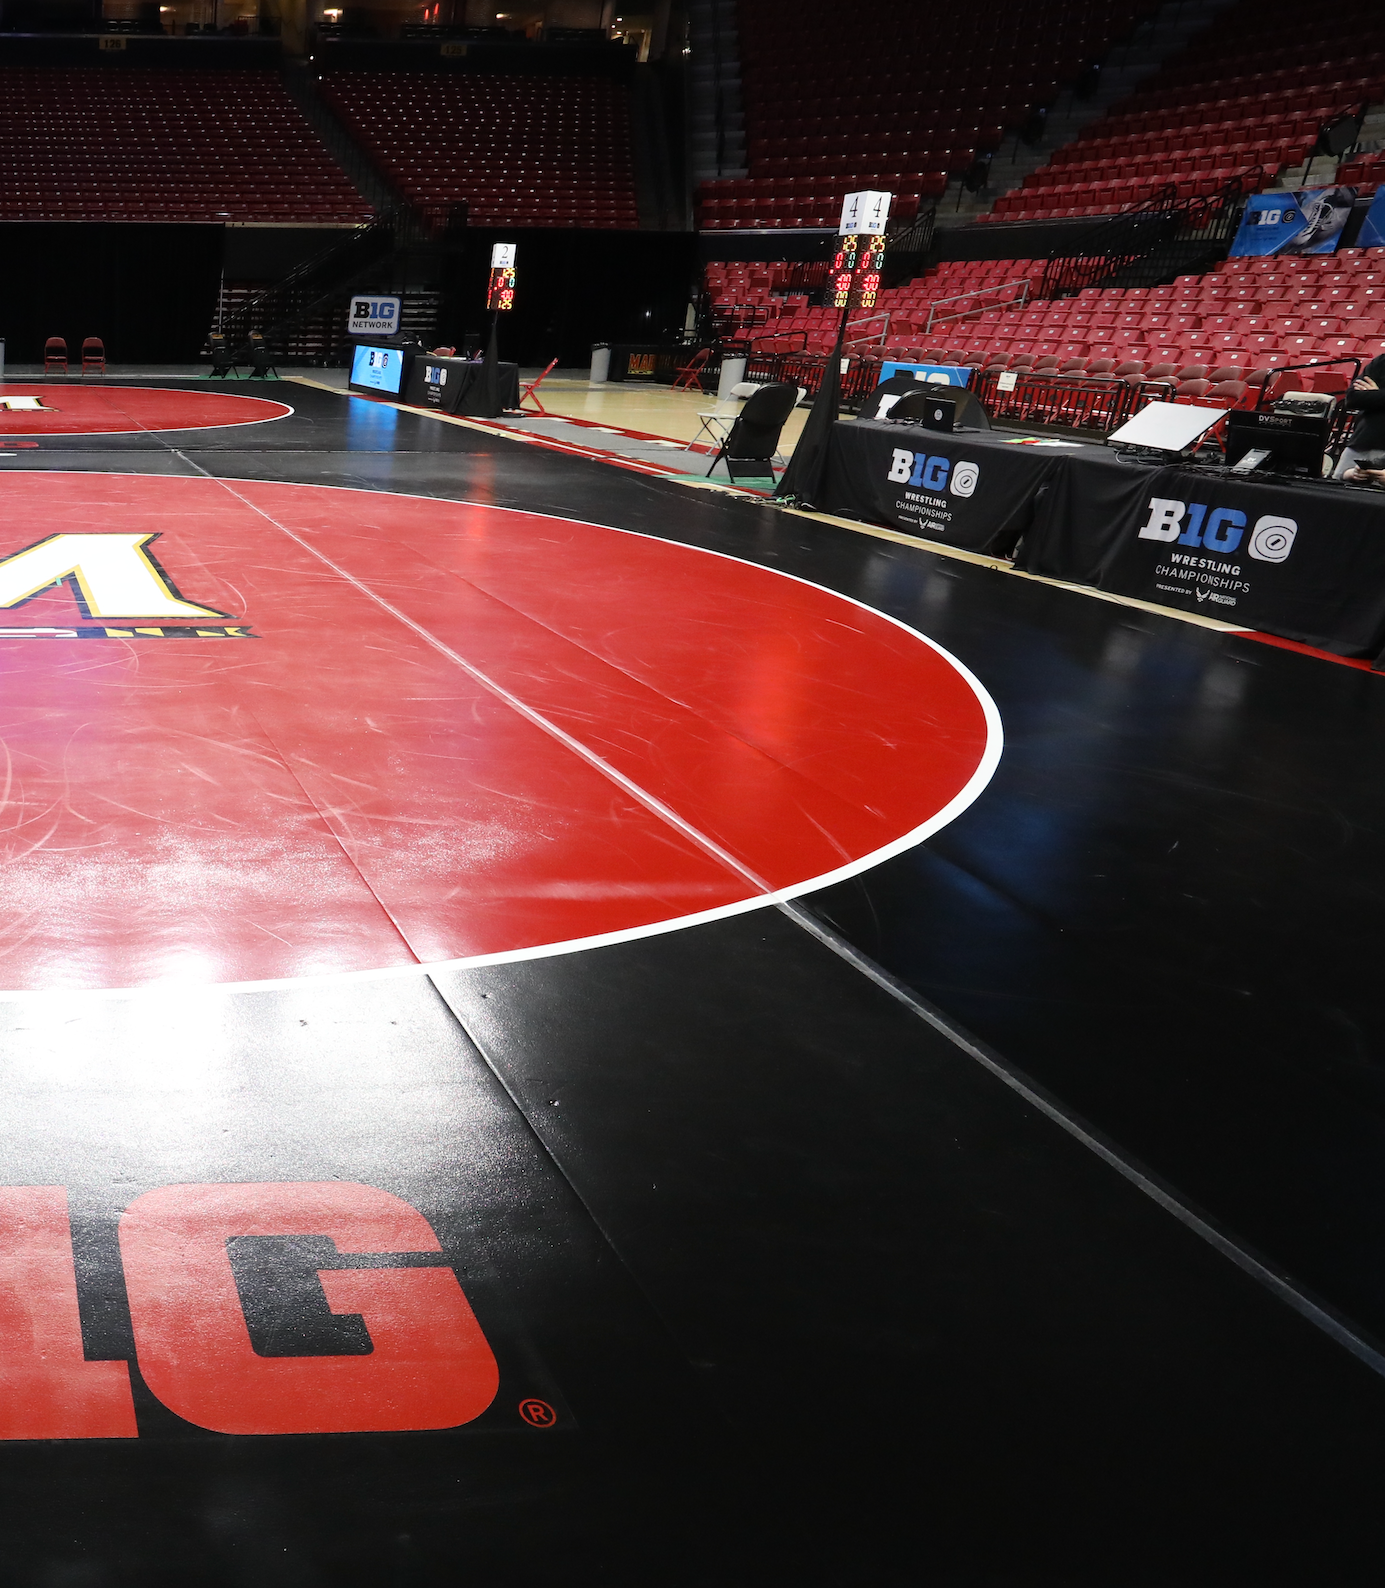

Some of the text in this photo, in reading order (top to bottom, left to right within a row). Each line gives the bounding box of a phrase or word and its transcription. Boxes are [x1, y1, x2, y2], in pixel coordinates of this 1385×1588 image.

[849, 196, 858, 217] 4
[873, 196, 882, 217] 4
[501, 246, 509, 258] 2
[352, 321, 393, 329] NETWORK
[905, 491, 947, 508] WRESTLING
[895, 500, 953, 521] CHAMPIONSHIPS
[1171, 553, 1241, 576] WRESTLING
[1155, 564, 1251, 593] CHAMPIONSHIPS
[1156, 583, 1185, 594] PRESENTED
